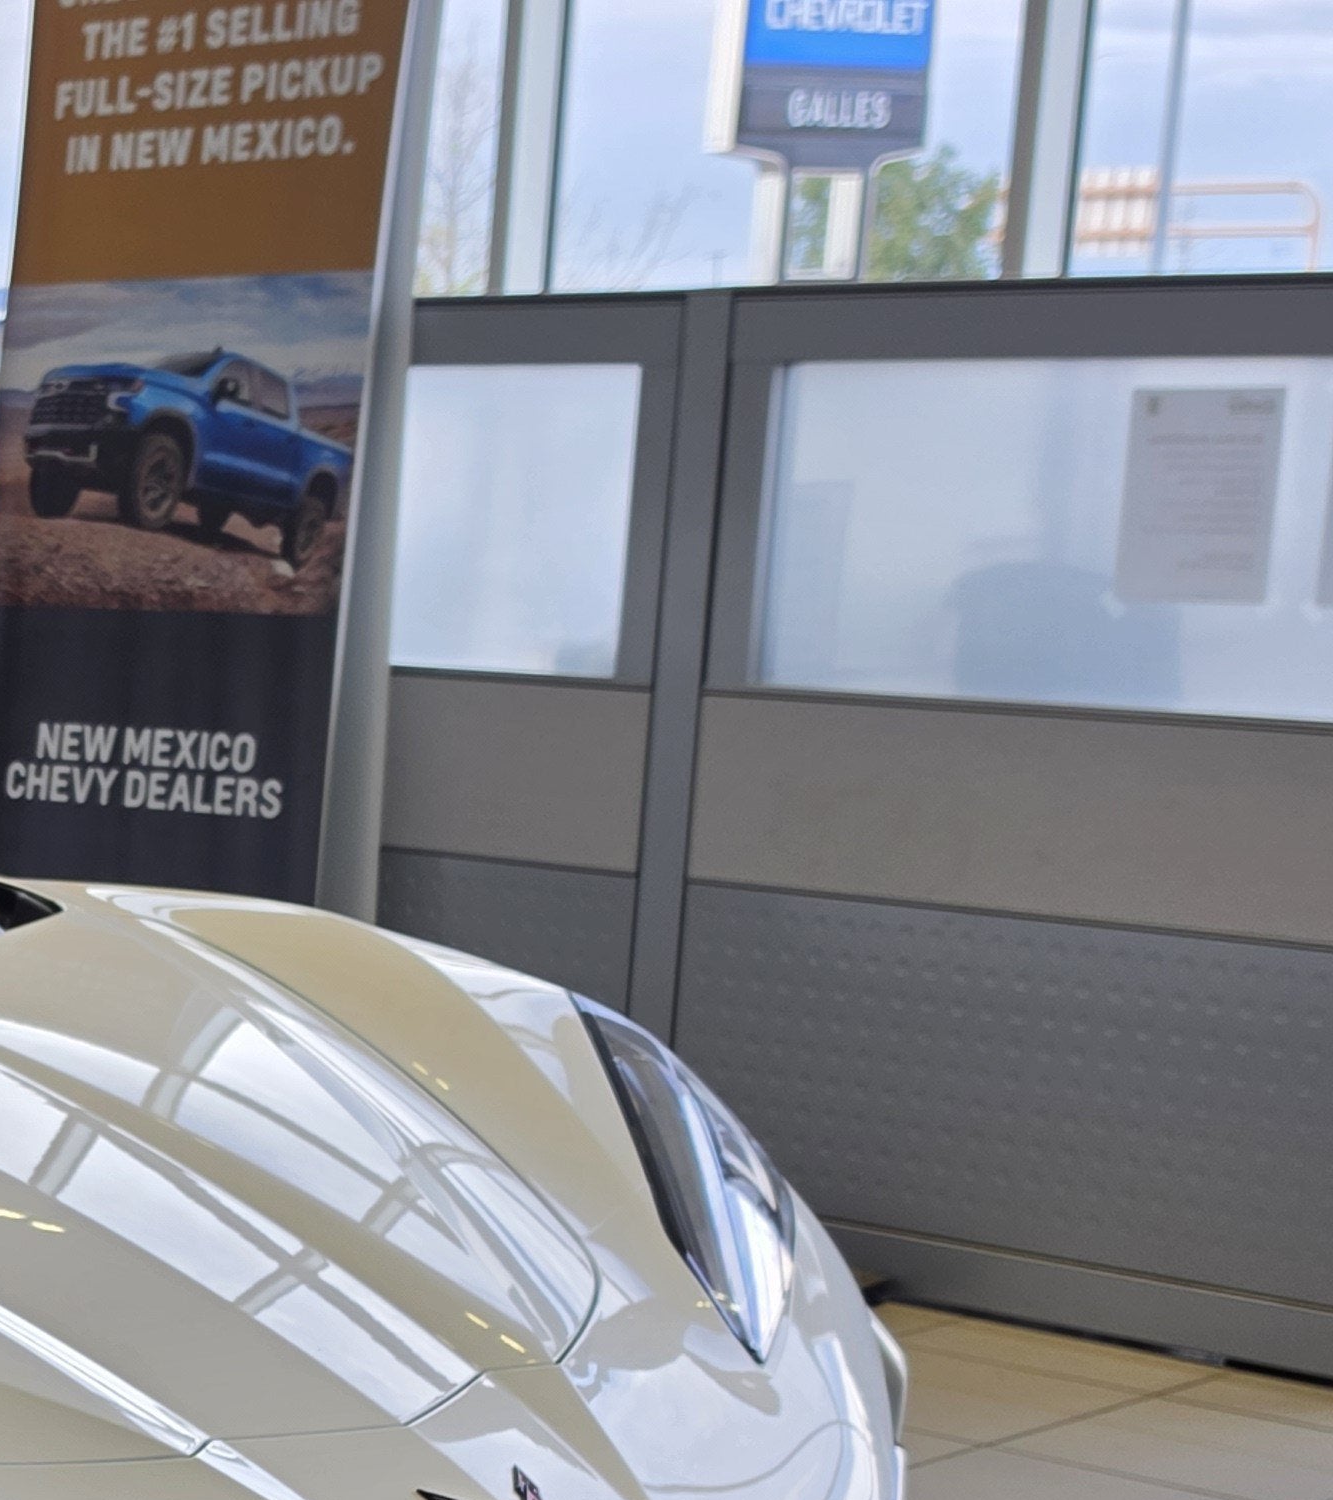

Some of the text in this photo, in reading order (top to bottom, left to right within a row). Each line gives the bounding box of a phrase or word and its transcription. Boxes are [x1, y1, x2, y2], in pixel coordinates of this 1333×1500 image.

[81, 0, 361, 61] THE #1 SELLING
[54, 53, 384, 120] FULL-SIZE PICKUP
[787, 88, 892, 130] GALLES
[64, 114, 357, 175] IN NEW MEXICO.
[36, 721, 257, 774] NEW MEXICO
[5, 761, 283, 820] CHEVY DEALERS
